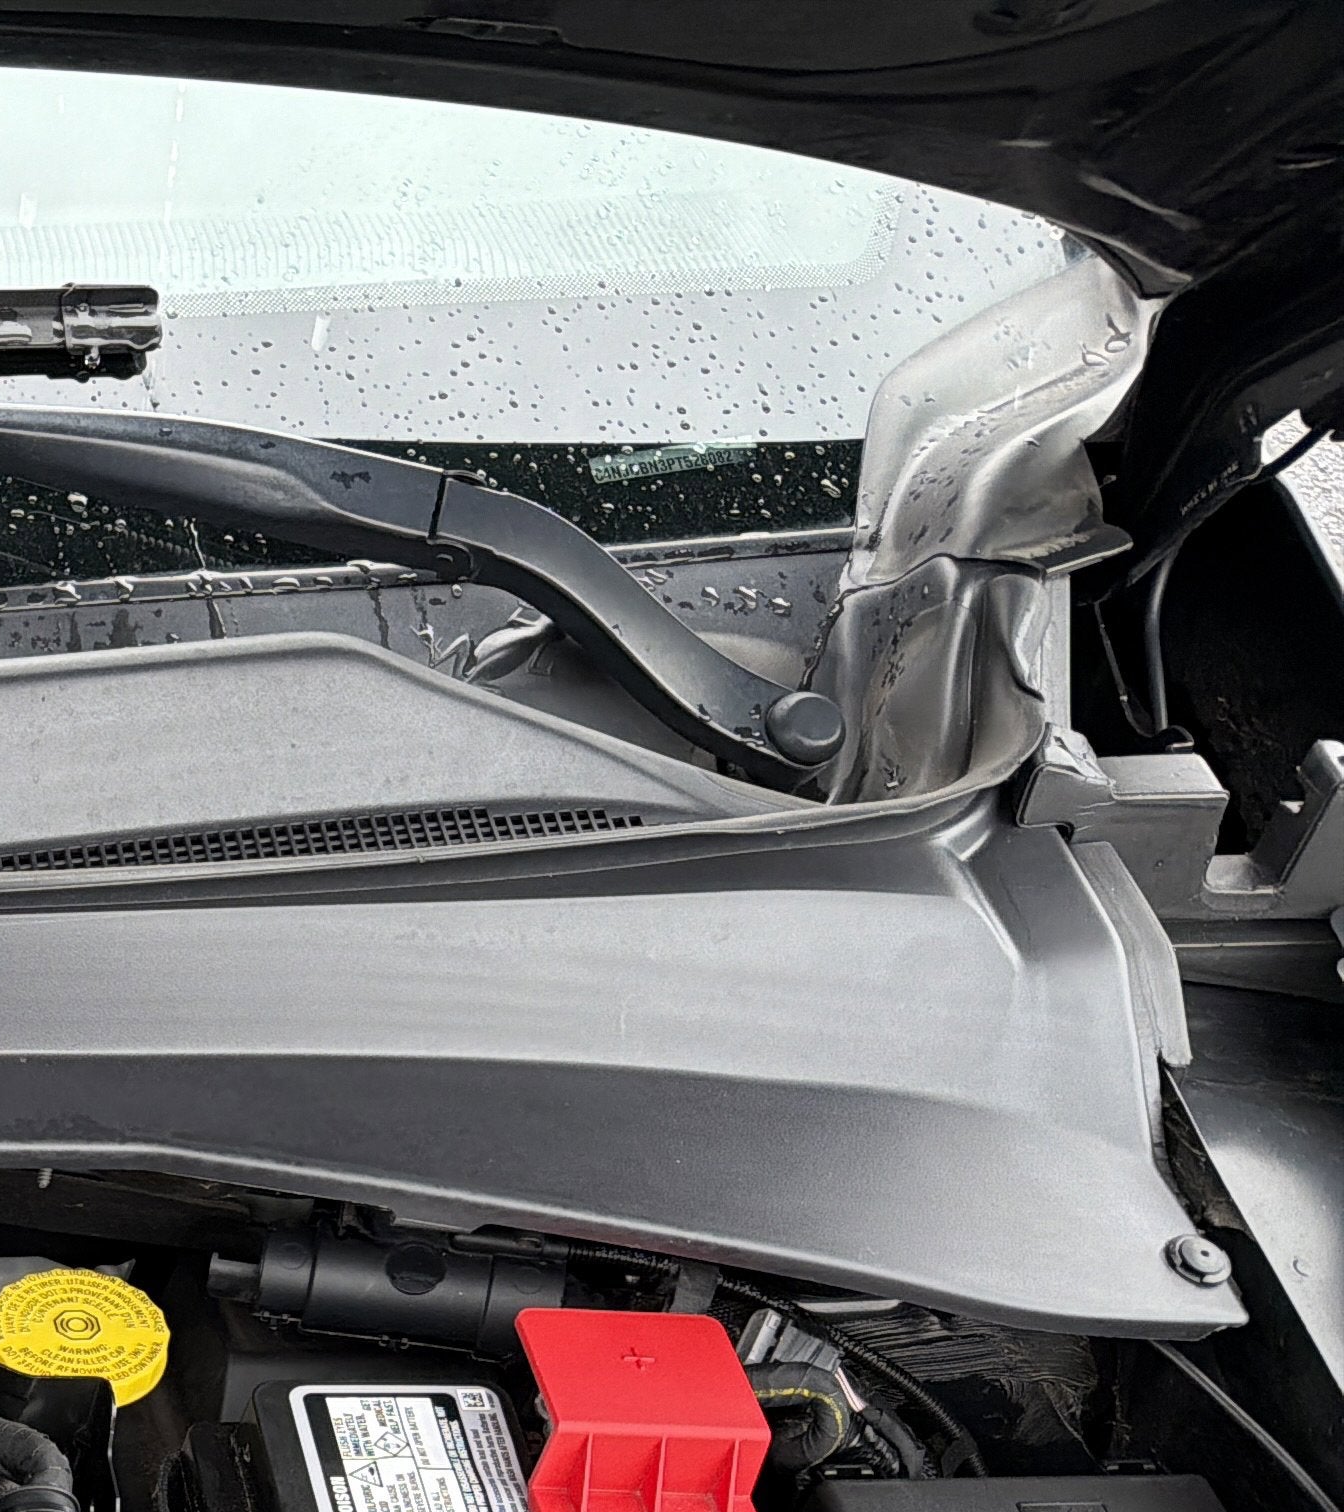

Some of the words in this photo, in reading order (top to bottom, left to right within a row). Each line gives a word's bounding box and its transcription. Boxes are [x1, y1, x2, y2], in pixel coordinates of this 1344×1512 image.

[60, 1287, 68, 1295] 3
[2, 1345, 22, 1361] DOT
[18, 1346, 55, 1368] BEFORE
[113, 1358, 129, 1370] USE
[40, 1348, 75, 1365] CLEAN
[77, 1354, 110, 1366] FILLER
[111, 1345, 125, 1359] CAP
